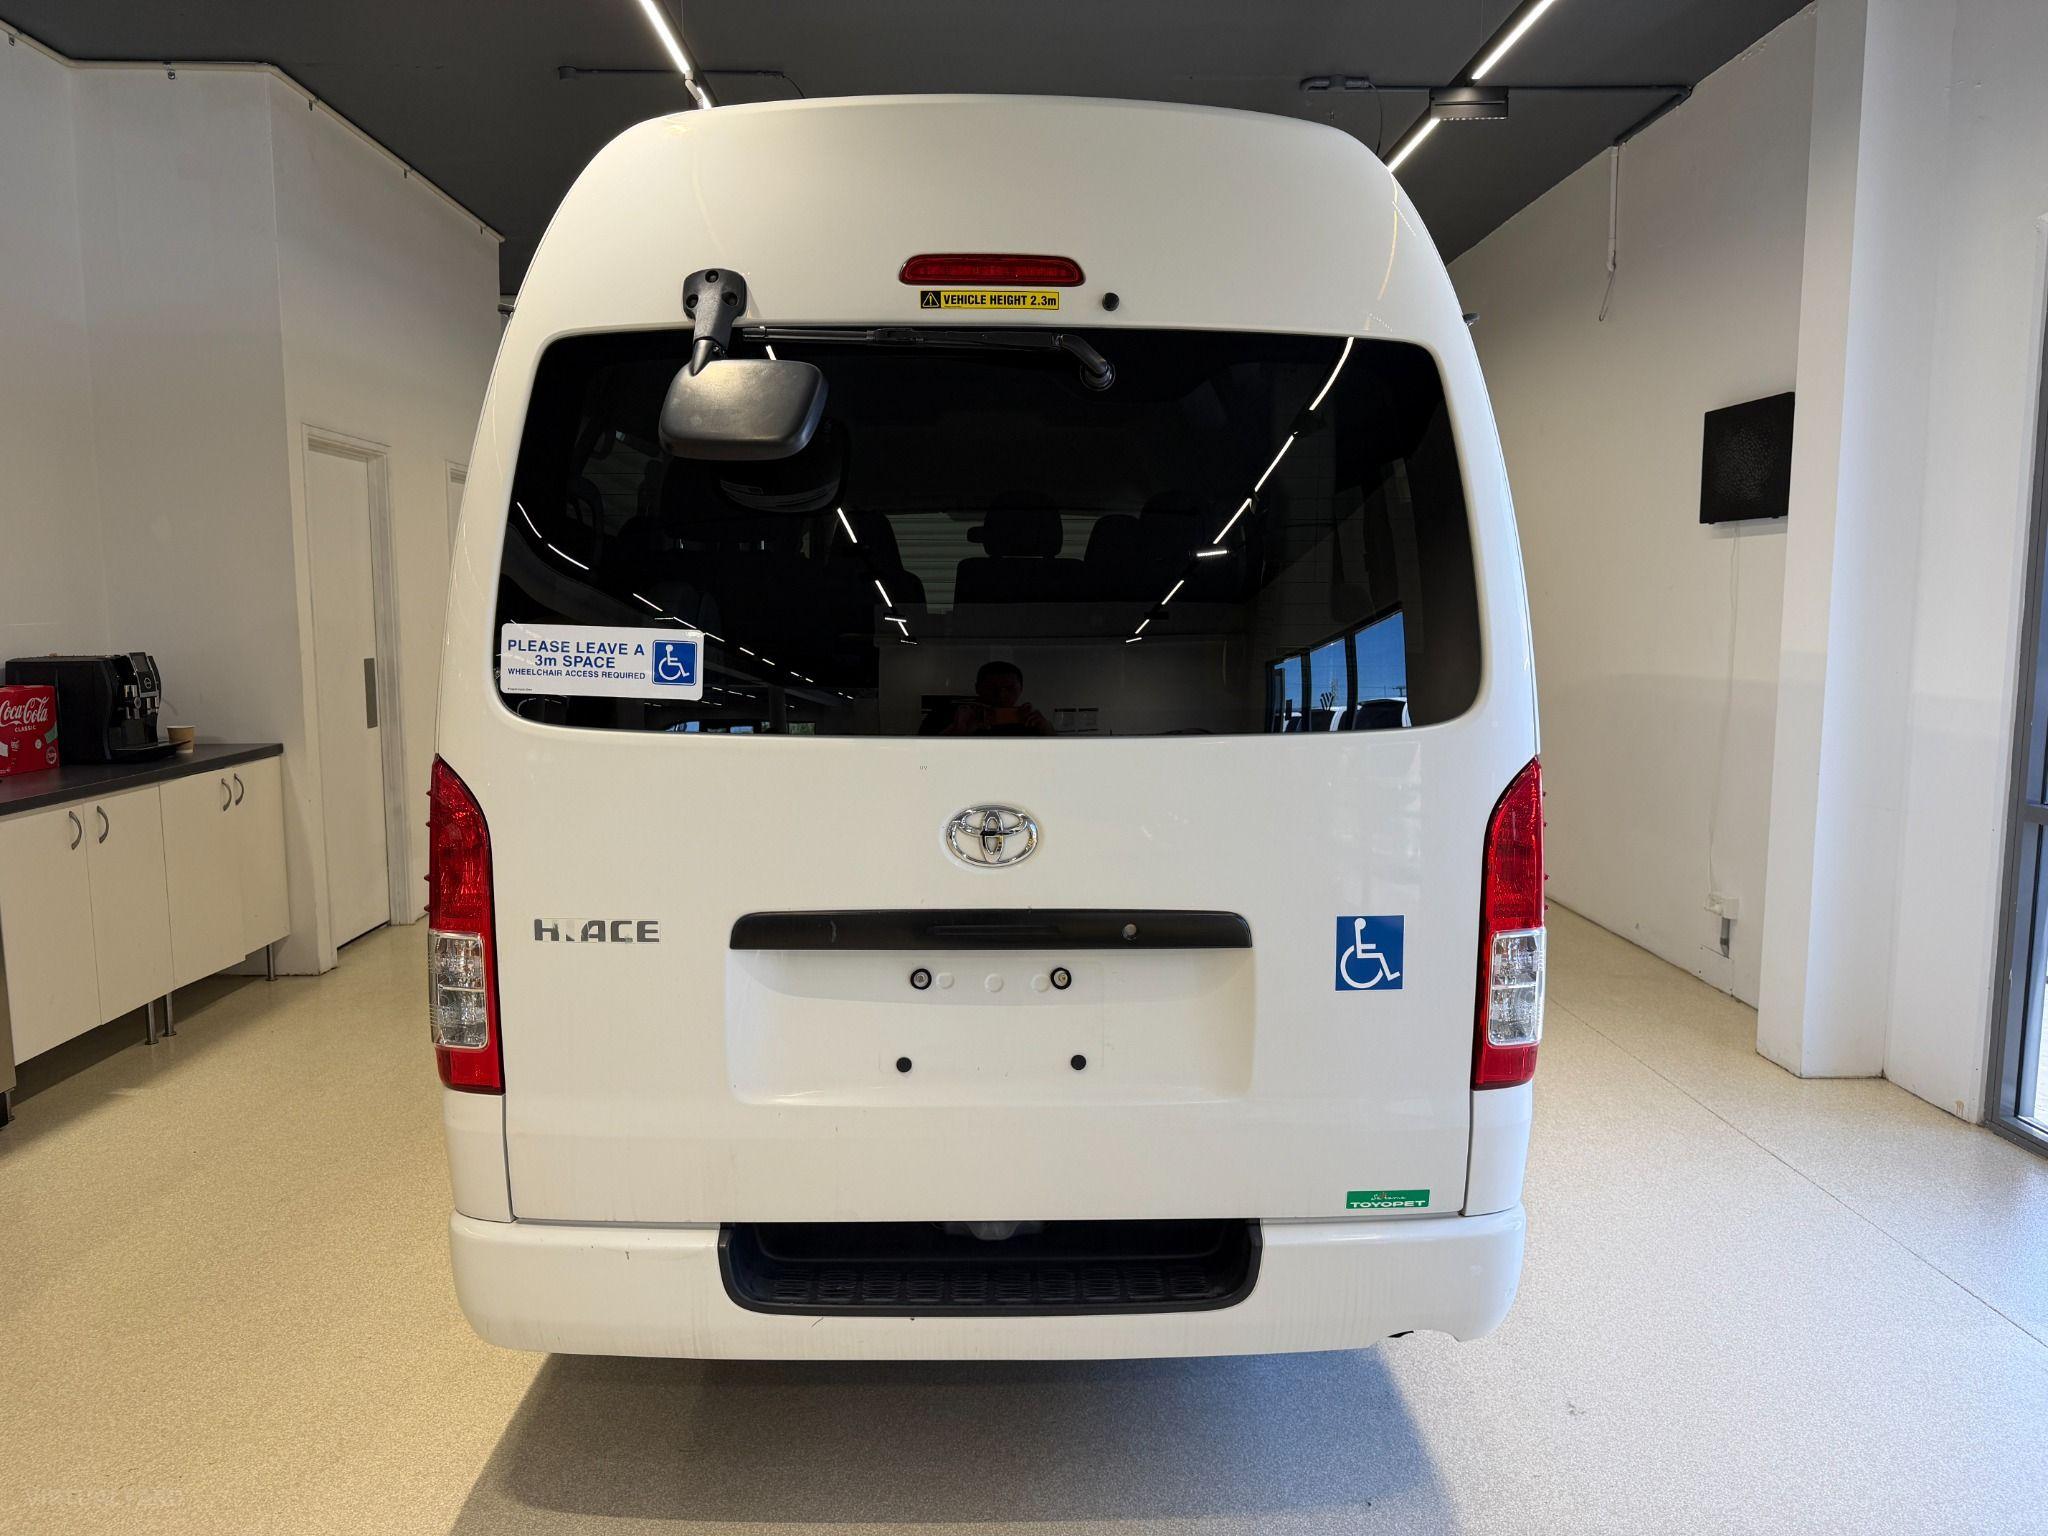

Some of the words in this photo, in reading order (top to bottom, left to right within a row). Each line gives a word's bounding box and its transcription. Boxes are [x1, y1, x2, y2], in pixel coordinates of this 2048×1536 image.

[943, 294, 986, 305] VEHICLE
[990, 294, 1028, 306] HEIGHT
[1030, 295, 1057, 306] 2.3m
[507, 639, 570, 653] PLEASE
[576, 641, 629, 656] LEAVE
[633, 643, 645, 656] A
[534, 655, 557, 667] 3m
[562, 655, 616, 669] SPACE
[507, 667, 563, 678] WHEELCHAIR
[564, 669, 600, 679] ACCESS
[601, 671, 646, 680] REQUIRED
[14, 725, 37, 733] CLASSIC
[534, 918, 660, 943] HACE
[1349, 1200, 1426, 1208] TOYOPET
